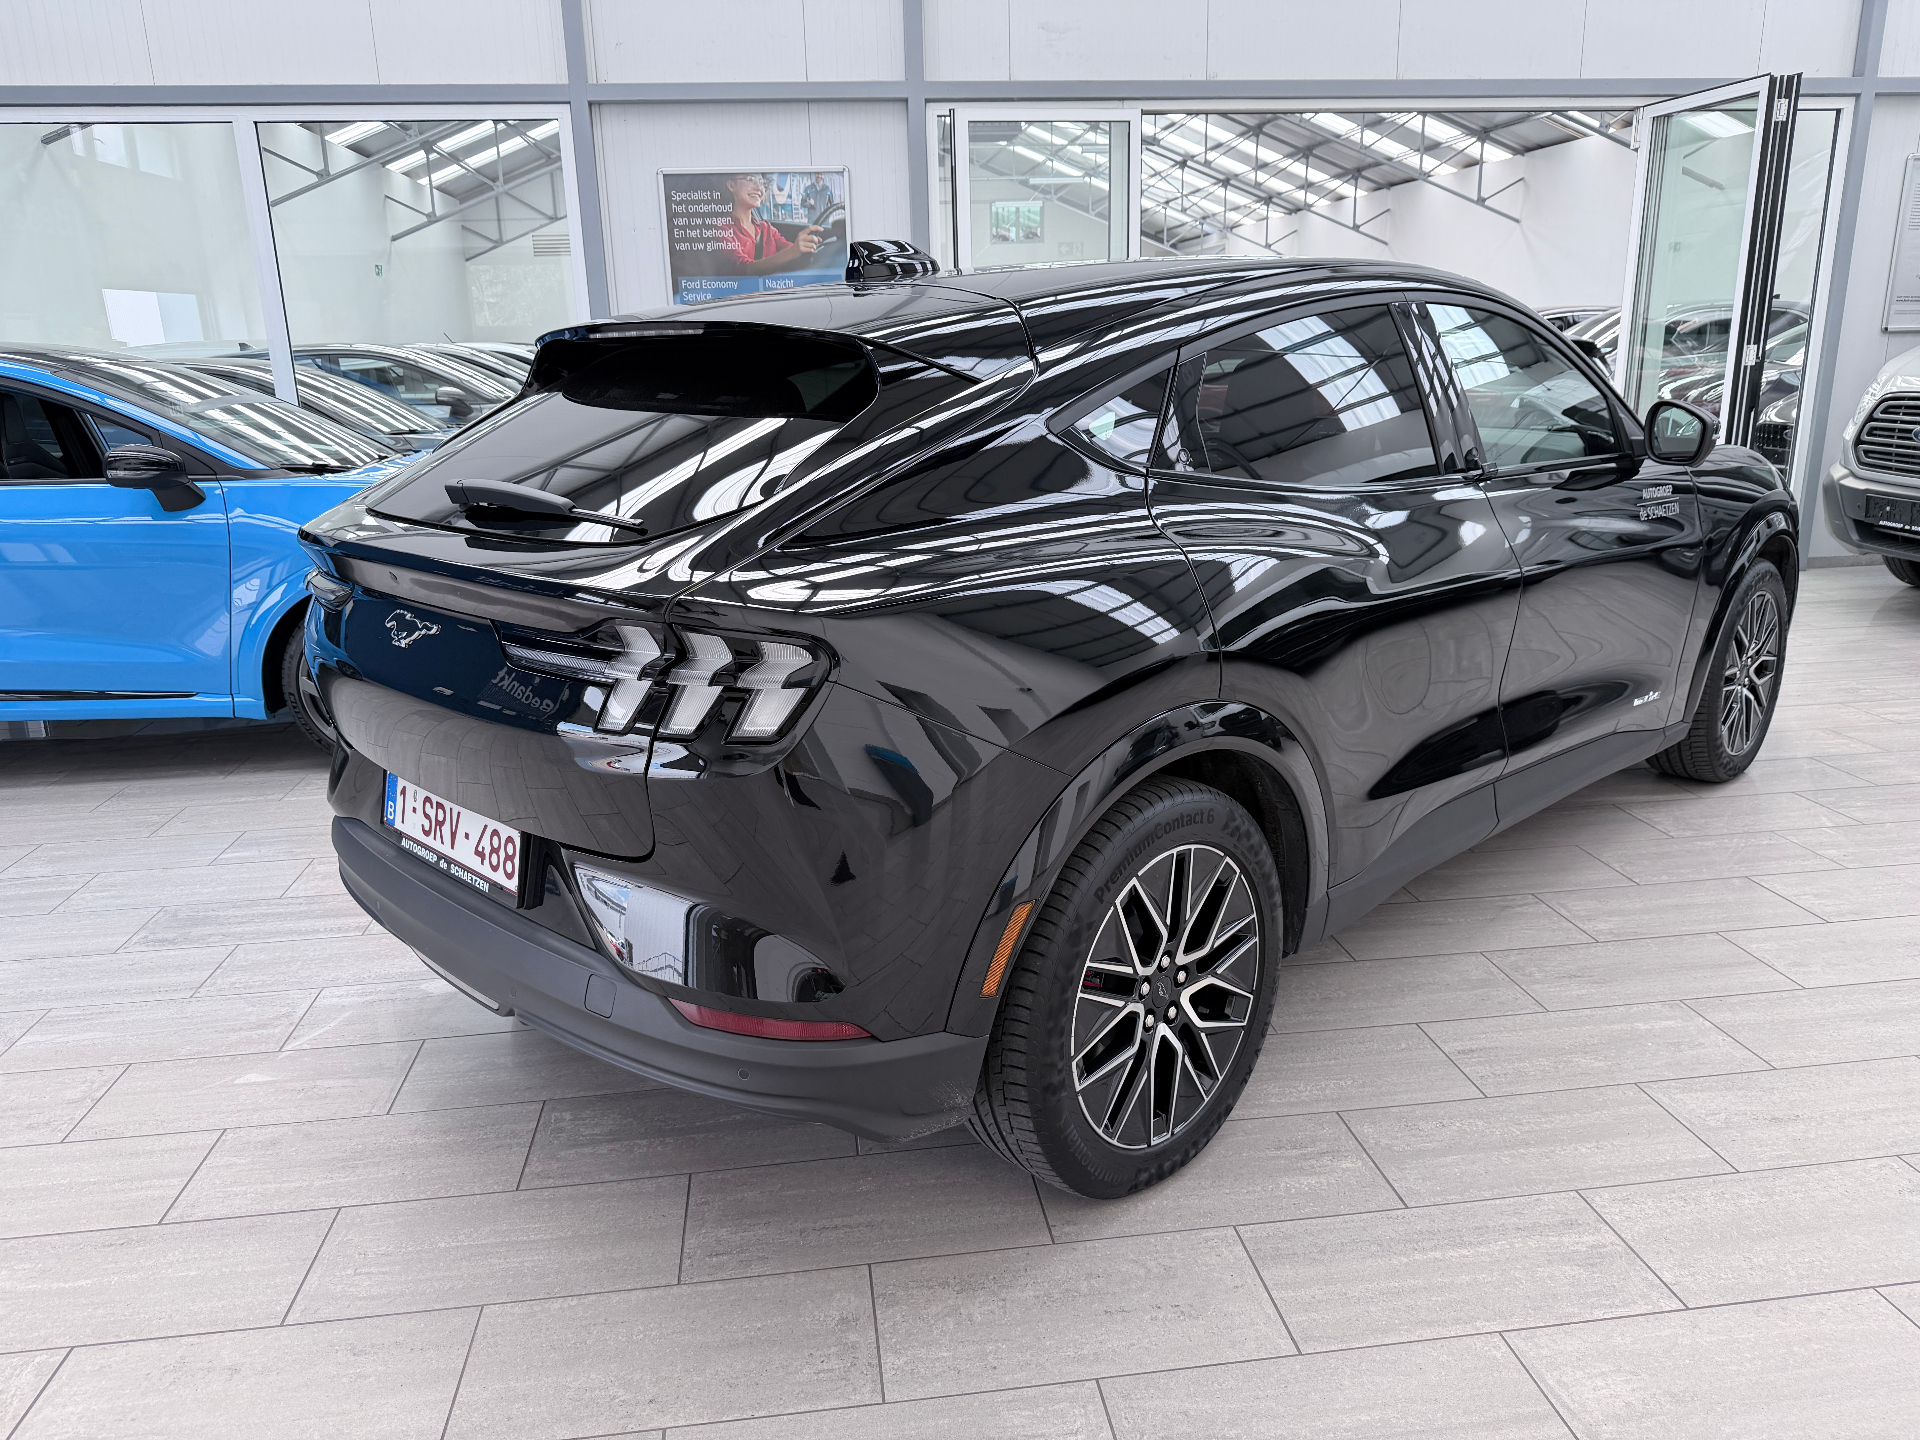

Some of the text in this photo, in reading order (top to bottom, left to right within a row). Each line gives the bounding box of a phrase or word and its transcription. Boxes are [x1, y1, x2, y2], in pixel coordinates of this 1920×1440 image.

[671, 190, 721, 201] Specialist in
[672, 202, 733, 213] het onderhoud
[673, 216, 734, 227] van uw wagen.
[674, 228, 734, 238] En het behoud
[675, 240, 744, 252] van uw glimlach.
[682, 280, 738, 291] Ford Economy
[765, 279, 794, 288] Nazicht
[683, 292, 712, 301] Service
[1642, 484, 1673, 500] AUTOGROEP
[1639, 501, 1680, 521] de SCHAETZEN
[386, 801, 395, 820] B
[1093, 810, 1205, 905] PremiumContact
[1206, 807, 1215, 825] 6
[400, 837, 490, 893] AUTOGROEP de SCHAETZEN
